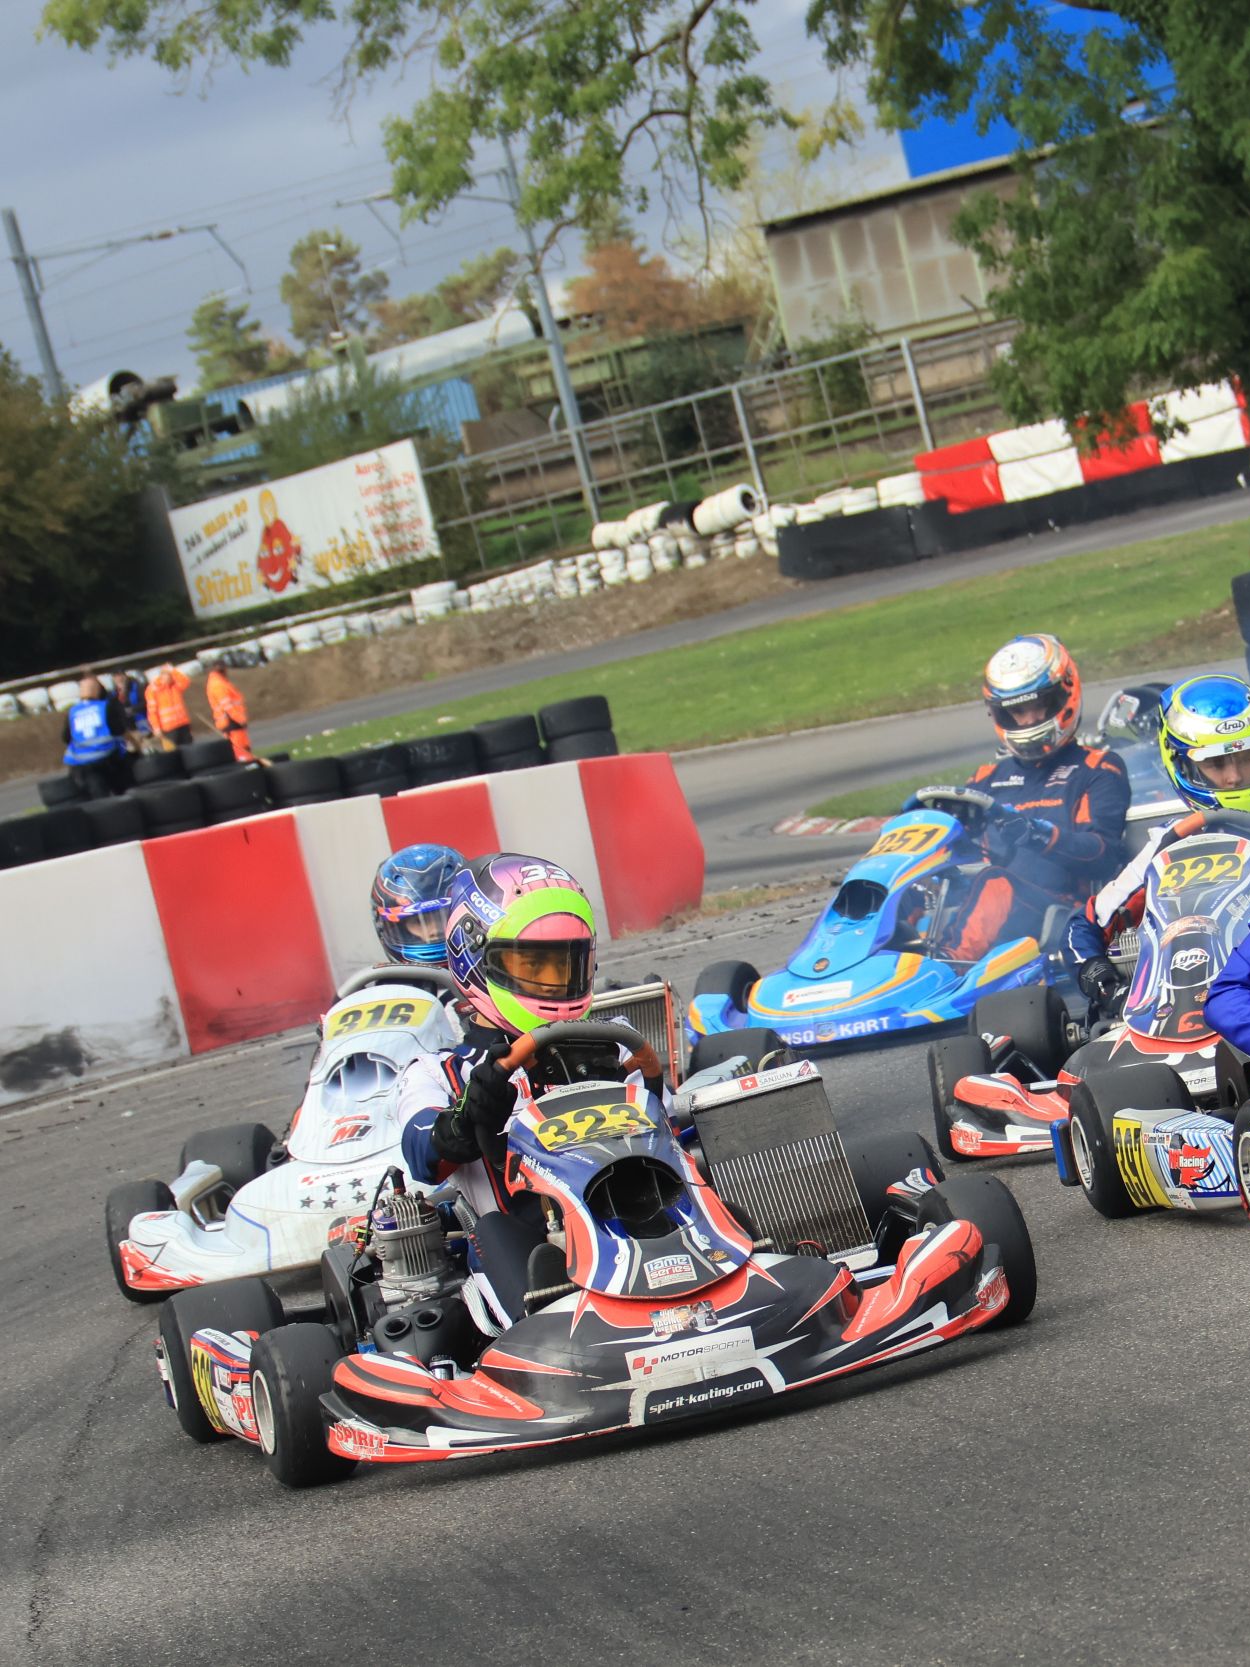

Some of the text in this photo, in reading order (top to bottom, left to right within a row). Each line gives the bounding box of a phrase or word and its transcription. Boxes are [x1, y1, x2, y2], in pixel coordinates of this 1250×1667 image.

[194, 560, 253, 608] Stützli
[1219, 720, 1243, 731] Arai
[520, 864, 572, 885] 33
[1160, 854, 1242, 893] 322
[470, 890, 501, 920] GOGO
[1173, 953, 1209, 967] Lynn
[332, 1002, 416, 1038] 316
[839, 1017, 891, 1036] KART
[537, 1103, 653, 1148] 323
[1179, 1156, 1205, 1168] Racing
[649, 1378, 764, 1415] spirit-karting.com
[334, 1422, 389, 1449] SPIRIT
